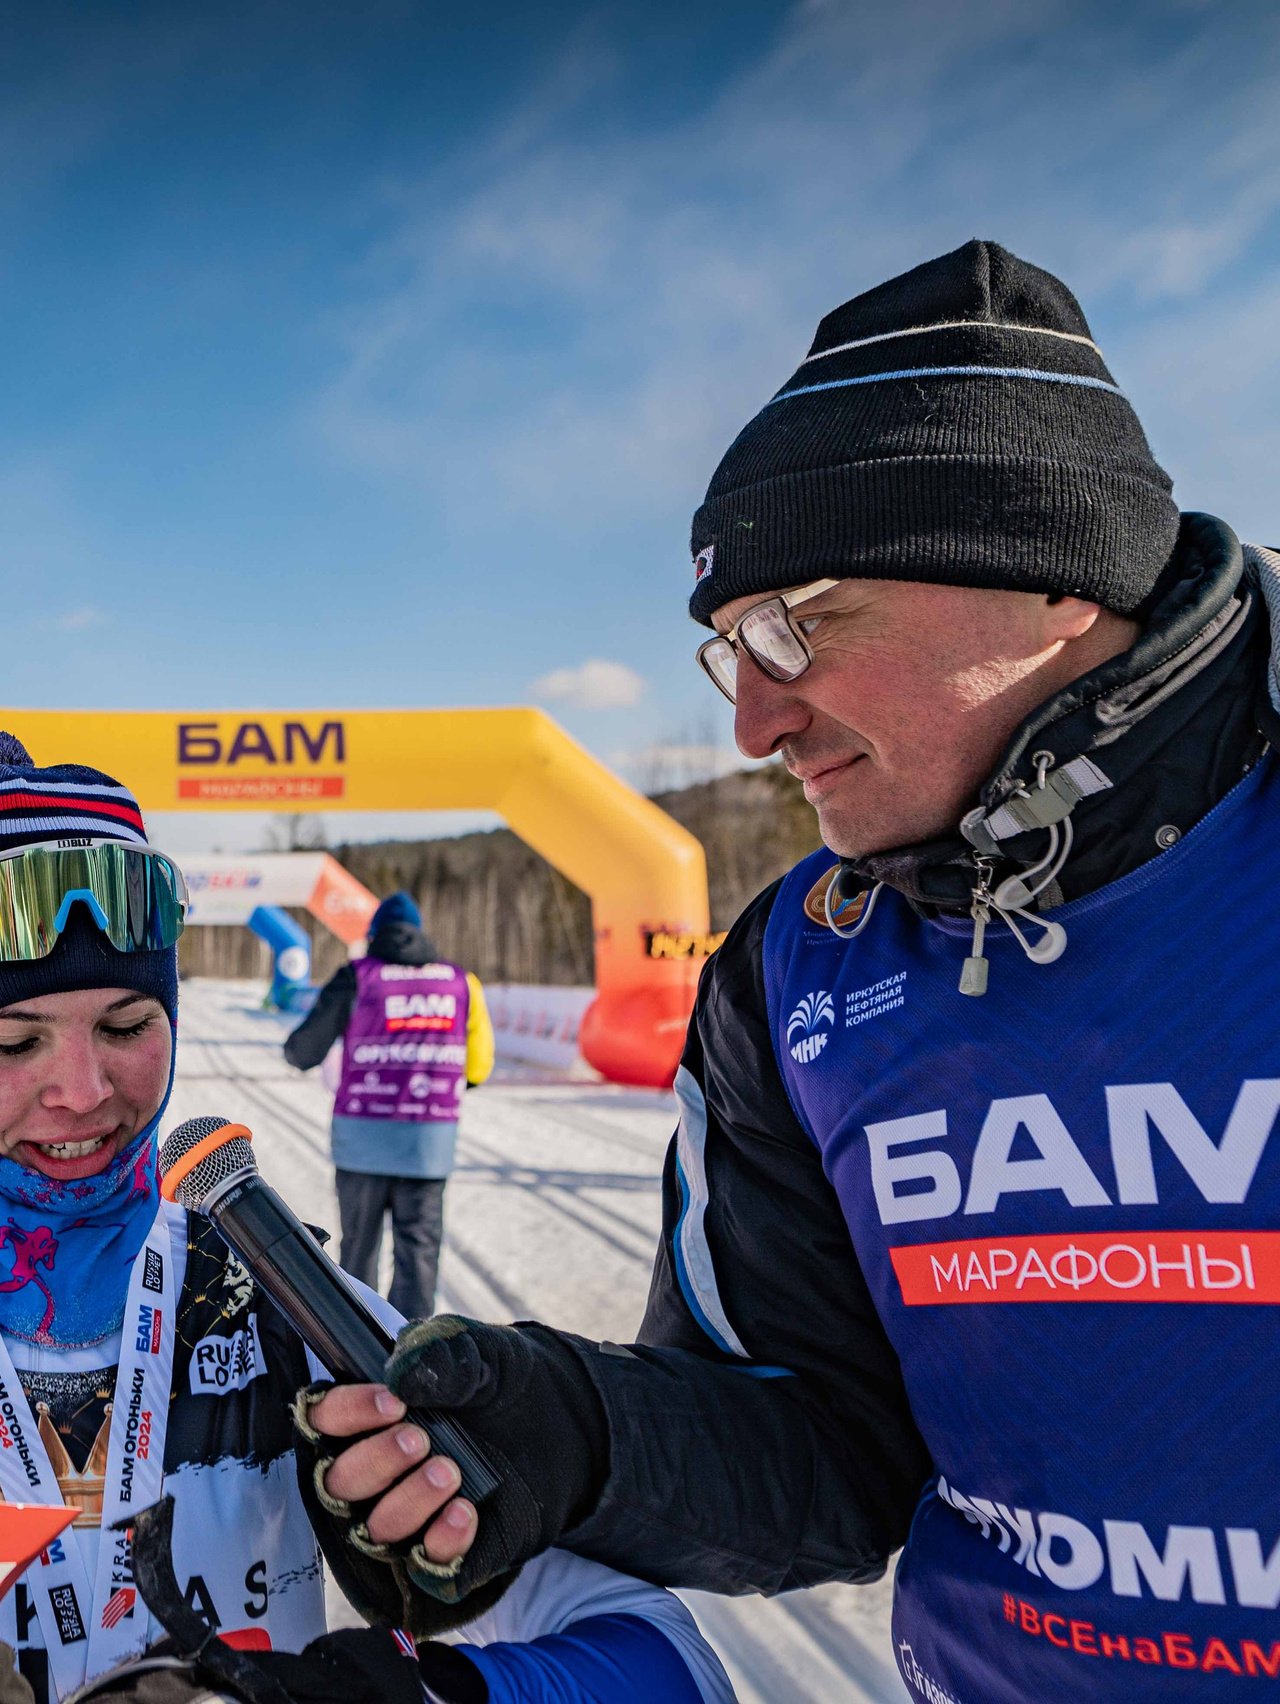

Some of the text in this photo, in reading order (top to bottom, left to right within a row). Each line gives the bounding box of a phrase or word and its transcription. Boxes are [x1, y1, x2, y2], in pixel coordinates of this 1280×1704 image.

[178, 723, 345, 766] БАМ
[846, 971, 907, 1003] ИРКУТСКАЯ
[846, 985, 902, 1015] НЕФТЯНАЯ
[846, 996, 905, 1027] КОМПАНИЯ
[790, 1033, 828, 1063] ИНК
[863, 1078, 1280, 1226] БАМ
[929, 1243, 1257, 1293] МАРАФОНЫ
[136, 1304, 153, 1352] БАМ
[2, 1402, 42, 1487] ОГОНЬКИ
[120, 1367, 145, 1503] БАМ ОГОНЬКИ
[137, 1410, 152, 1460] 2024
[111, 1529, 127, 1582] KRA
